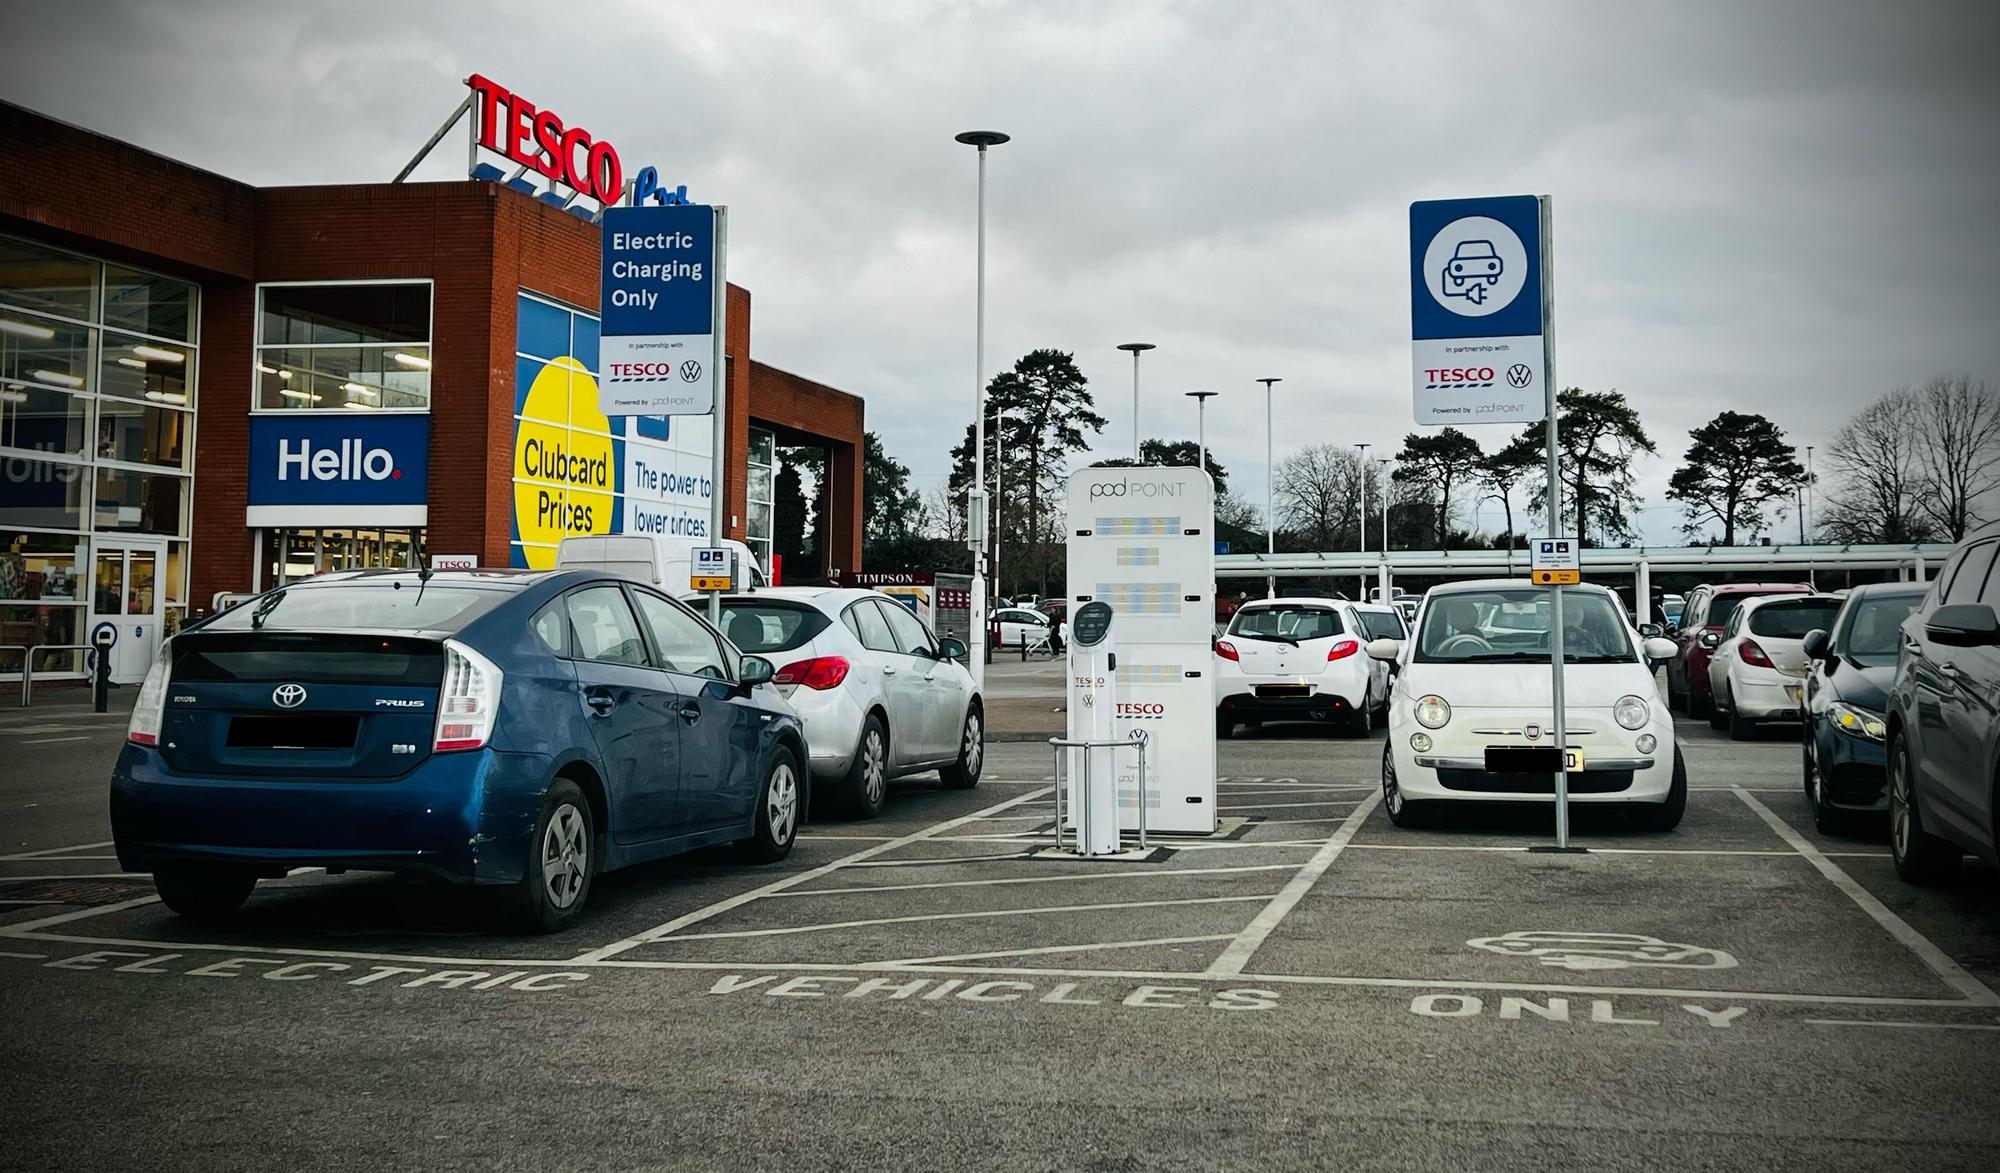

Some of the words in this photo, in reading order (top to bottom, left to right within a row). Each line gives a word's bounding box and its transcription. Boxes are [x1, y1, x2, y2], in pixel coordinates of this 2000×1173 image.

[468, 73, 622, 206] TESCO
[612, 231, 693, 251] Electric
[612, 260, 703, 282] Charging
[611, 289, 658, 310] Only
[635, 342, 669, 350] partnership
[1453, 345, 1493, 354] partnership
[609, 363, 670, 376] TESCO
[1424, 367, 1495, 383] TESCO
[641, 399, 648, 407] by
[1432, 406, 1461, 414] Powered
[1463, 407, 1471, 415] by
[1496, 404, 1526, 412] POINT
[278, 438, 402, 481] Hello.
[524, 438, 607, 487] Clubcard
[635, 460, 657, 490] The
[661, 472, 698, 498] power
[700, 473, 711, 499] to
[1090, 477, 1127, 503] pod
[1130, 482, 1186, 497] POINT
[538, 490, 593, 532] Prices
[634, 504, 668, 534] lower
[438, 560, 472, 569] TESCO
[855, 573, 914, 584] TIMPSON
[375, 699, 425, 707] PRIUS
[1116, 703, 1164, 714] TESCO
[42, 950, 590, 992] ELECTRIC
[707, 974, 1281, 1011] VEHICLES
[1409, 994, 1747, 1028] ONLY
